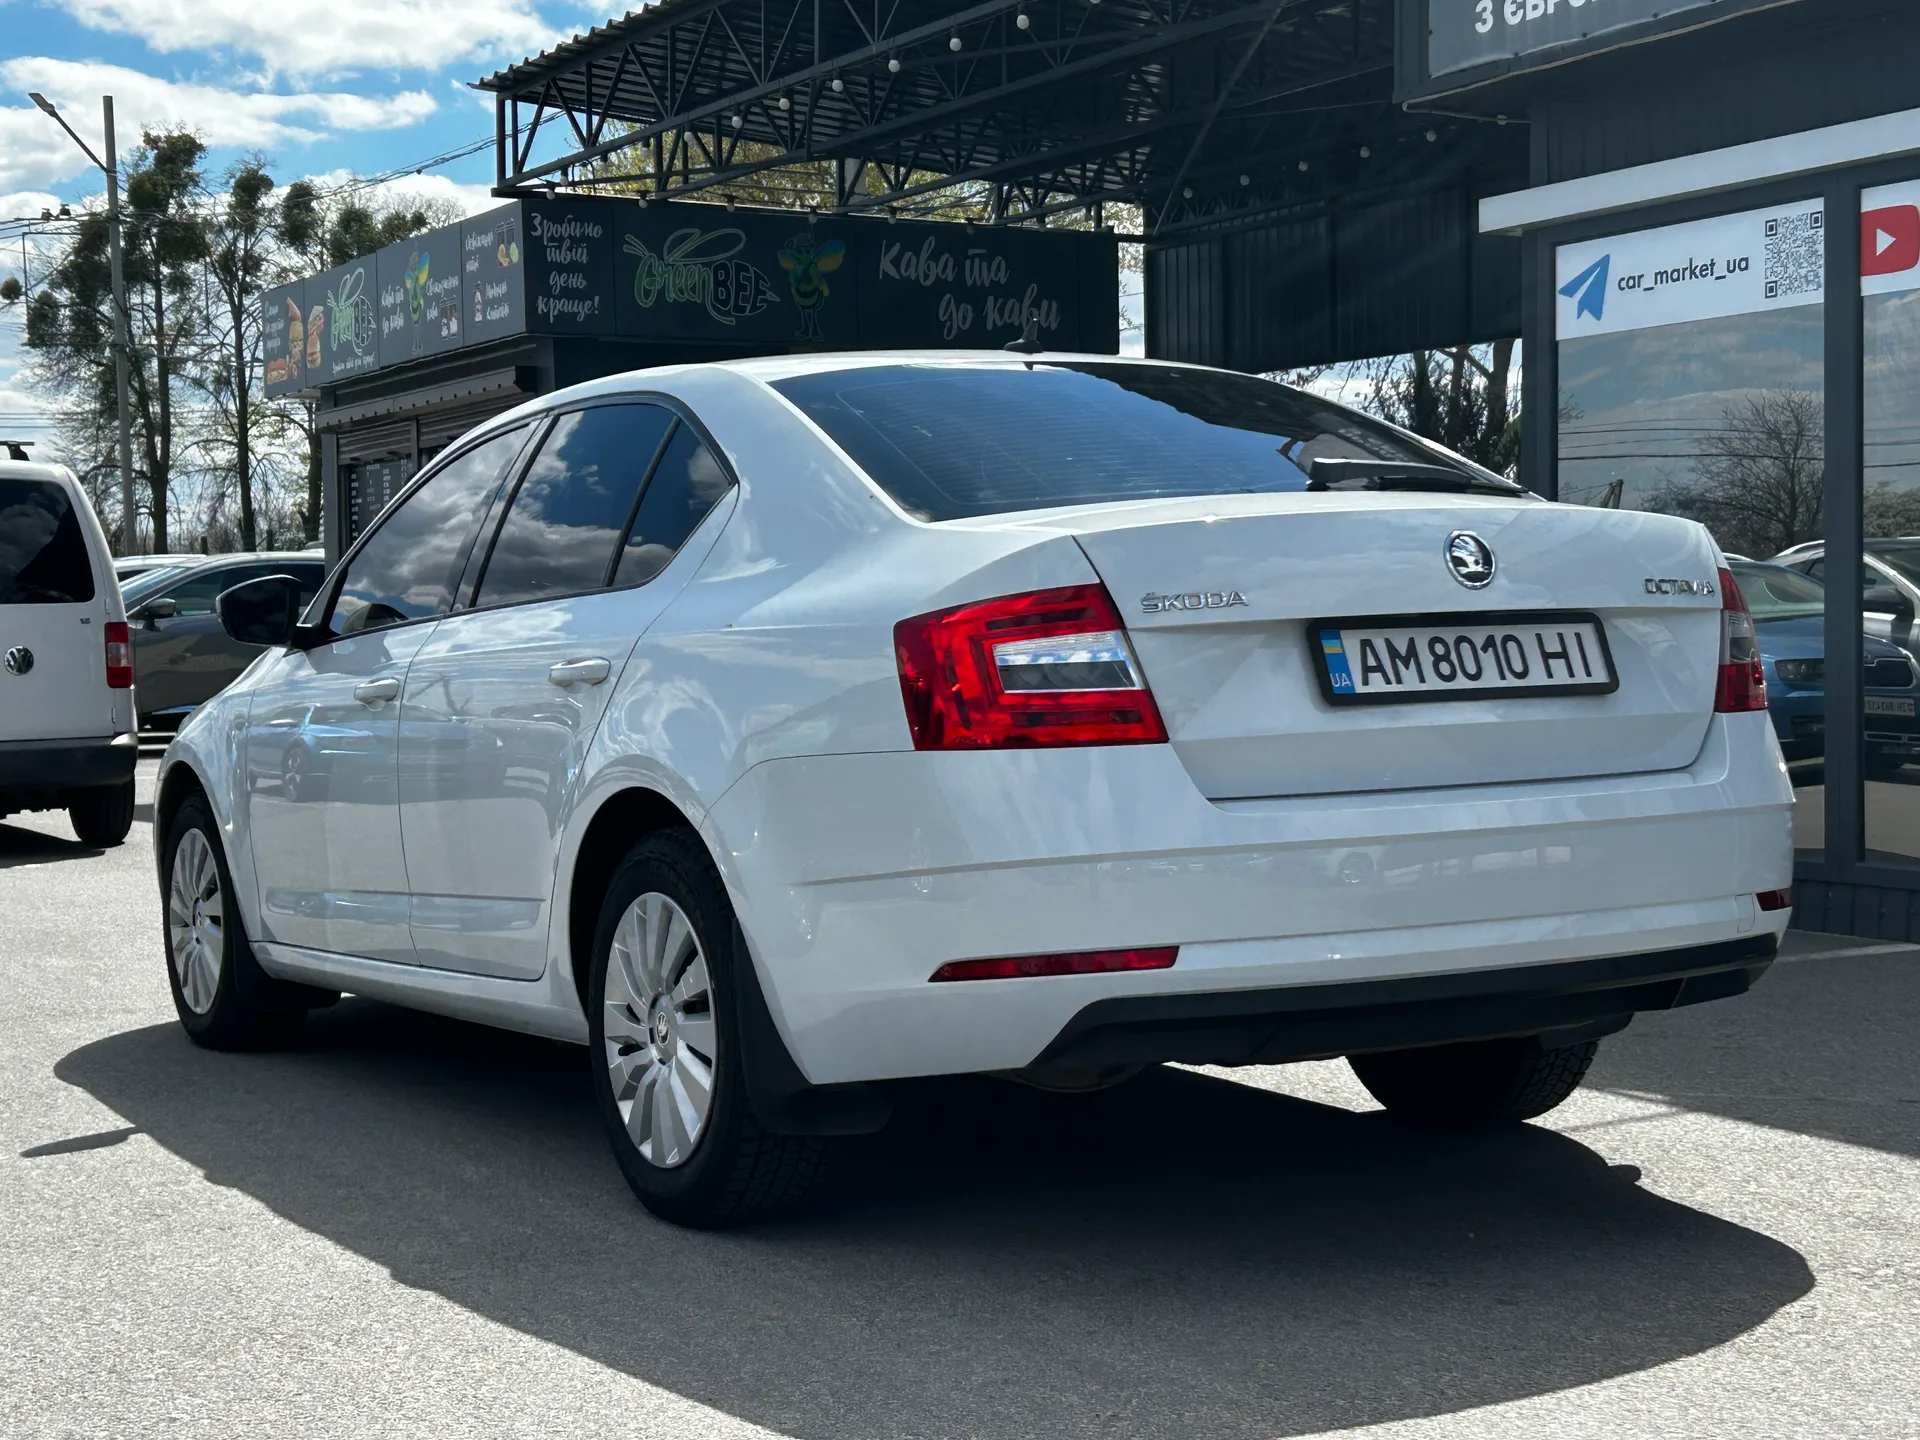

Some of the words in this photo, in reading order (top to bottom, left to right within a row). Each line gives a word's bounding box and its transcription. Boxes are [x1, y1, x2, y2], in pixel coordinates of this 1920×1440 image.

[530, 212, 604, 246] Зробимо
[546, 238, 589, 264] твій
[879, 236, 958, 286] Кава
[964, 249, 1010, 287] та
[549, 271, 588, 295] день
[1617, 256, 1749, 292] car_market_ua
[536, 295, 600, 324] краще!
[938, 293, 975, 340] до
[982, 283, 1061, 331] кави
[1140, 591, 1249, 613] ŠKODA
[1643, 578, 1715, 597] OCTAVIA
[1359, 637, 1426, 686] AM
[1427, 634, 1530, 683] 8010
[1535, 632, 1593, 680] HI
[1330, 673, 1351, 688] UA
